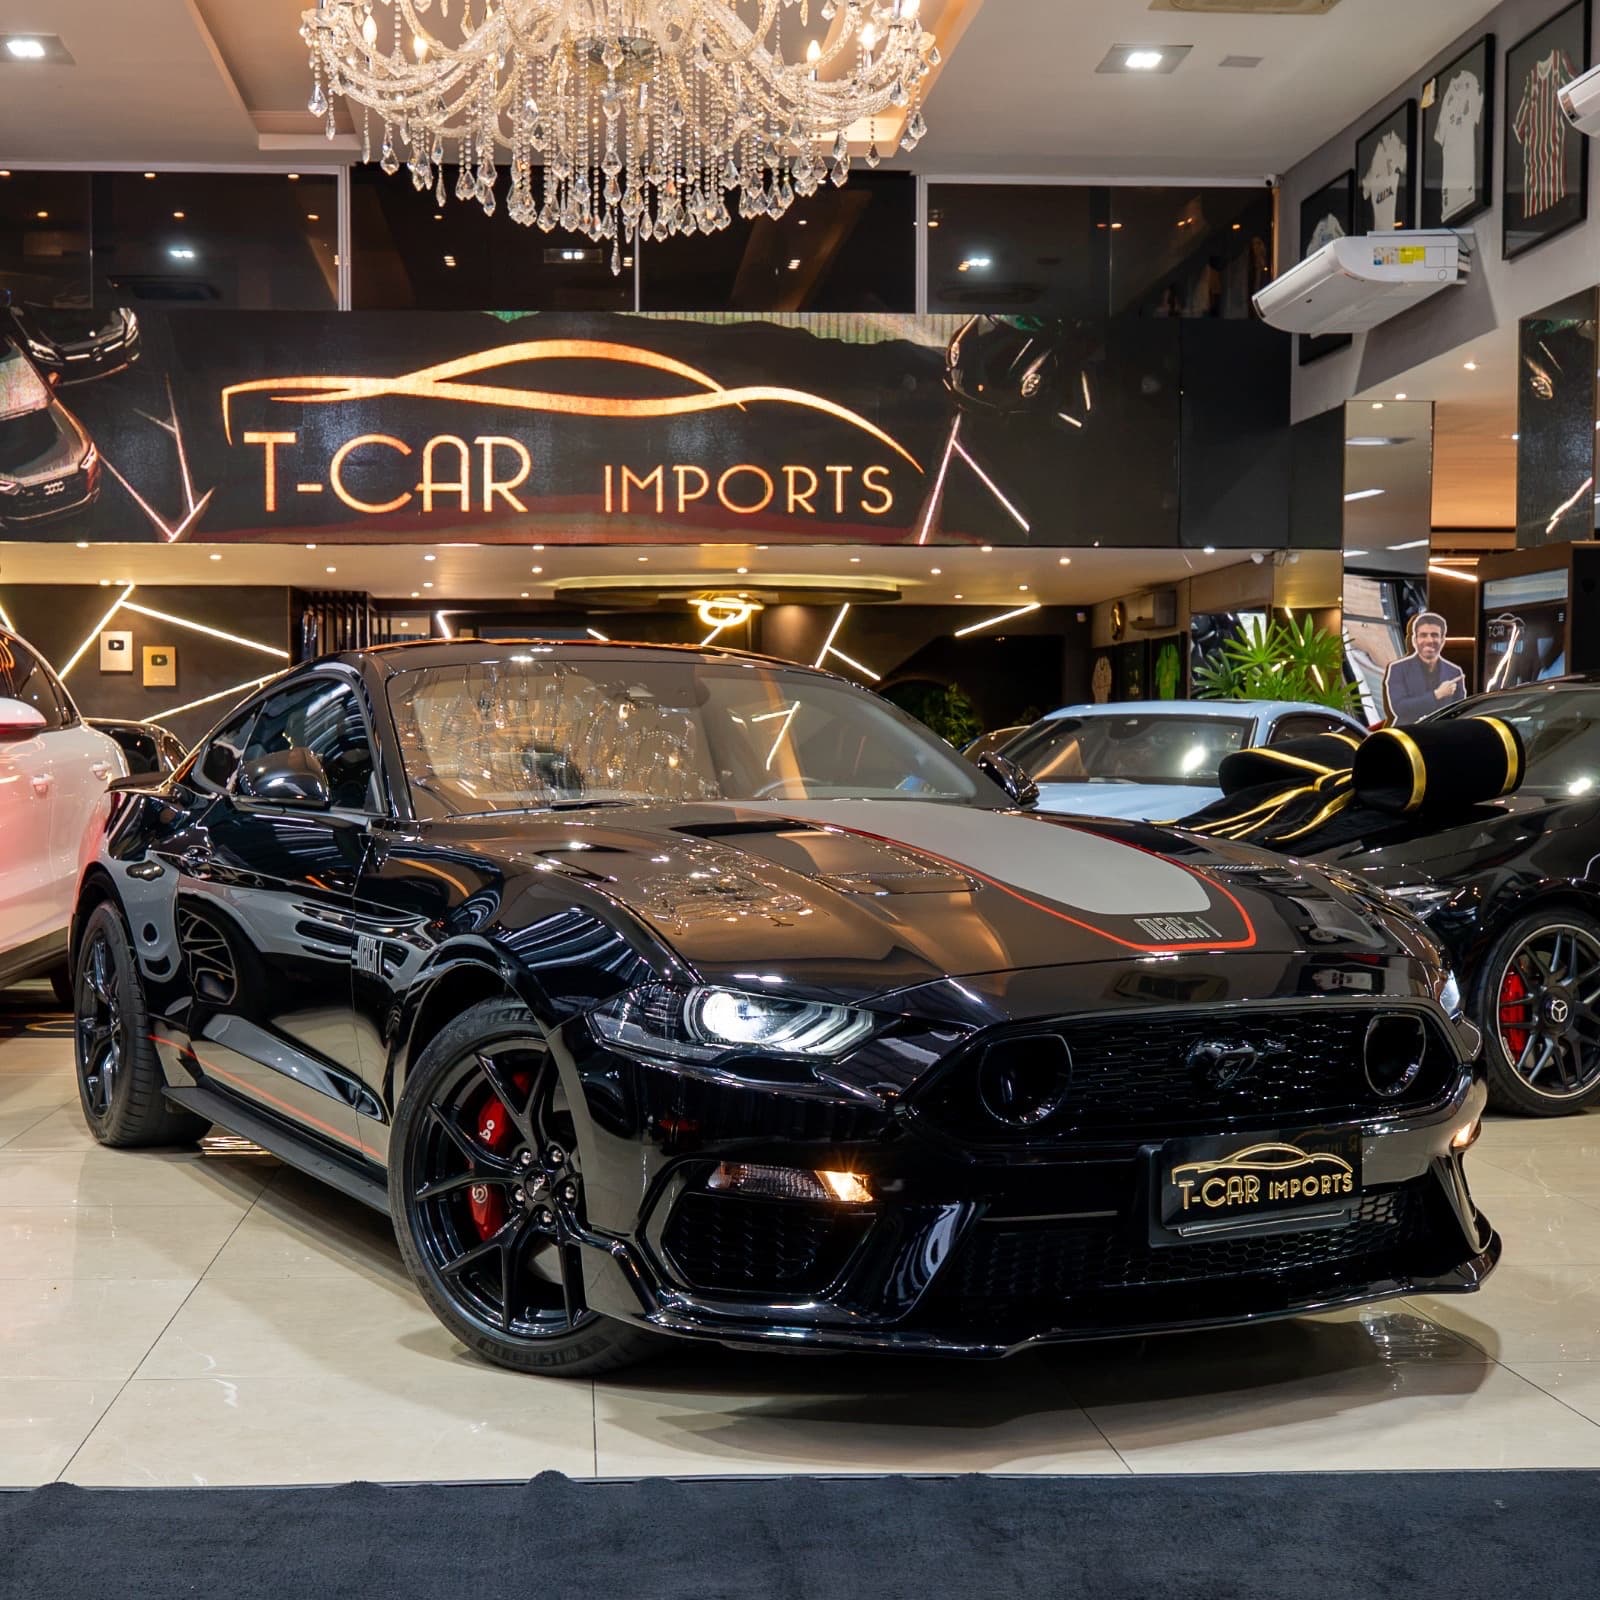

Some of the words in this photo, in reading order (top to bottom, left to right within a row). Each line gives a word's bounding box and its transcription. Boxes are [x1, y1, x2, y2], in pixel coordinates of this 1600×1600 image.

[243, 431, 531, 513] T-CAR
[603, 464, 894, 514] IMPORTS
[482, 1010, 531, 1023] MICHE
[1178, 1175, 1261, 1210] T-CAR
[1269, 1173, 1353, 1200] IMPORTS
